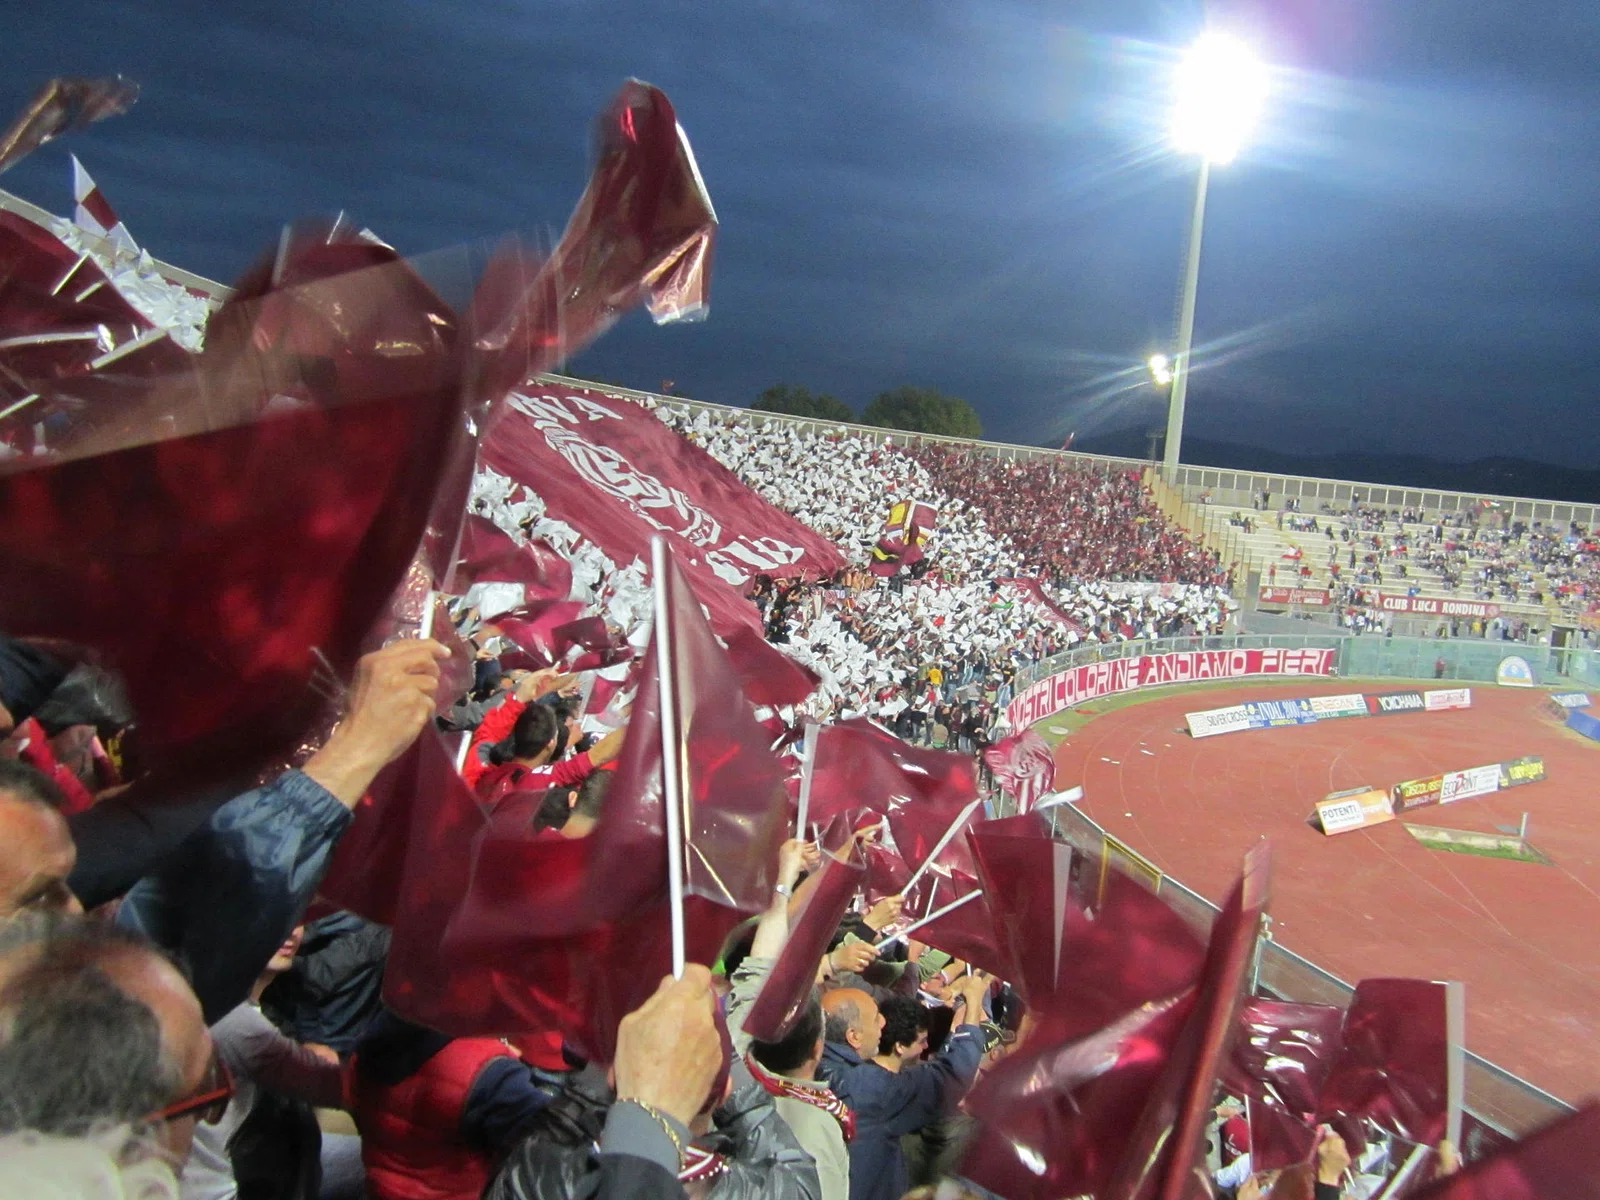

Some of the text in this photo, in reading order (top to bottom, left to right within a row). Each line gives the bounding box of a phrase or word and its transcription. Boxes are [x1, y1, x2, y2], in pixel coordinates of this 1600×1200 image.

[1383, 597, 1485, 616] CLUB LUCA RONDINA
[1010, 648, 1328, 736] NOSTRI COLORI NE ANDIAMO FIERI
[1206, 712, 1228, 727] SILVER
[1321, 804, 1357, 819] POTENTI
